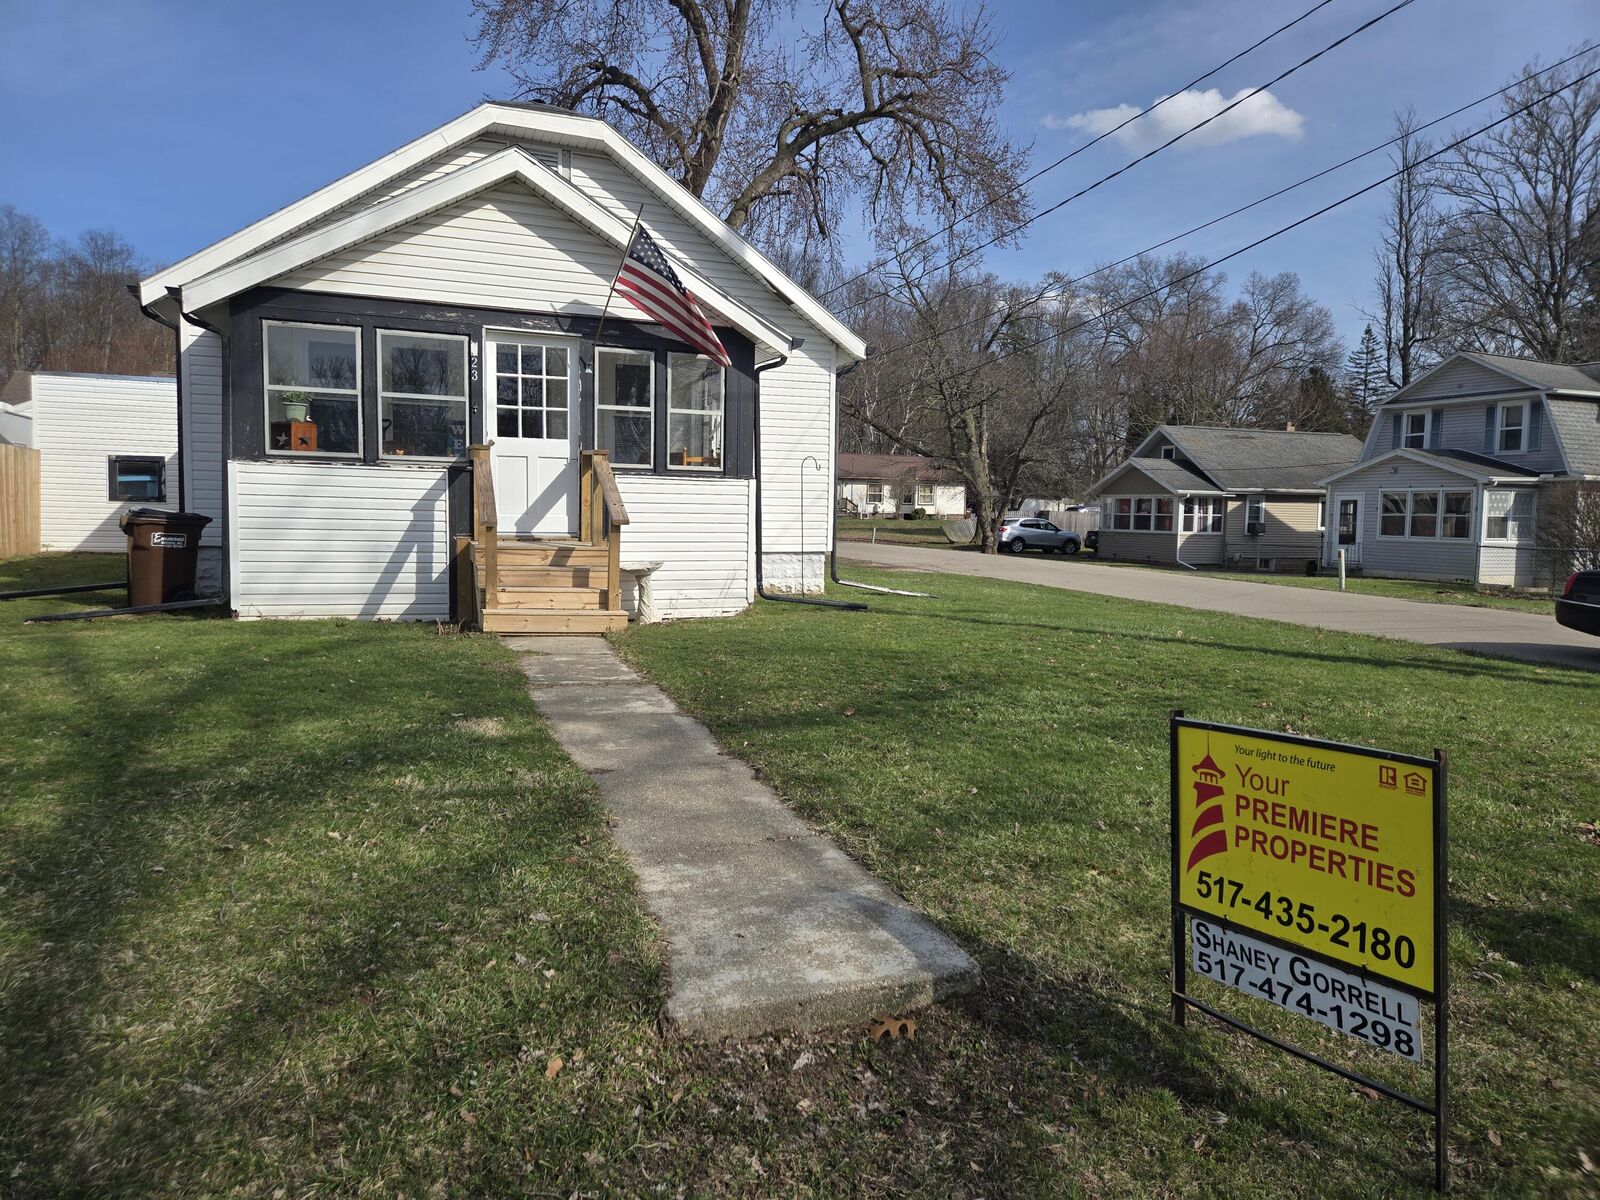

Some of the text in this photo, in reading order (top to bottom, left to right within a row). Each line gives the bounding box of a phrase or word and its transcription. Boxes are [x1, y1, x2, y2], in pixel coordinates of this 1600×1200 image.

[1235, 744, 1335, 772] Your light to the future
[1235, 763, 1290, 796] Your
[1235, 794, 1380, 852] PREMIERE
[1234, 824, 1416, 898] PROPERTIES
[1196, 870, 1415, 970] 517-435-2180
[1197, 955, 1414, 1057] 517-474-1298
